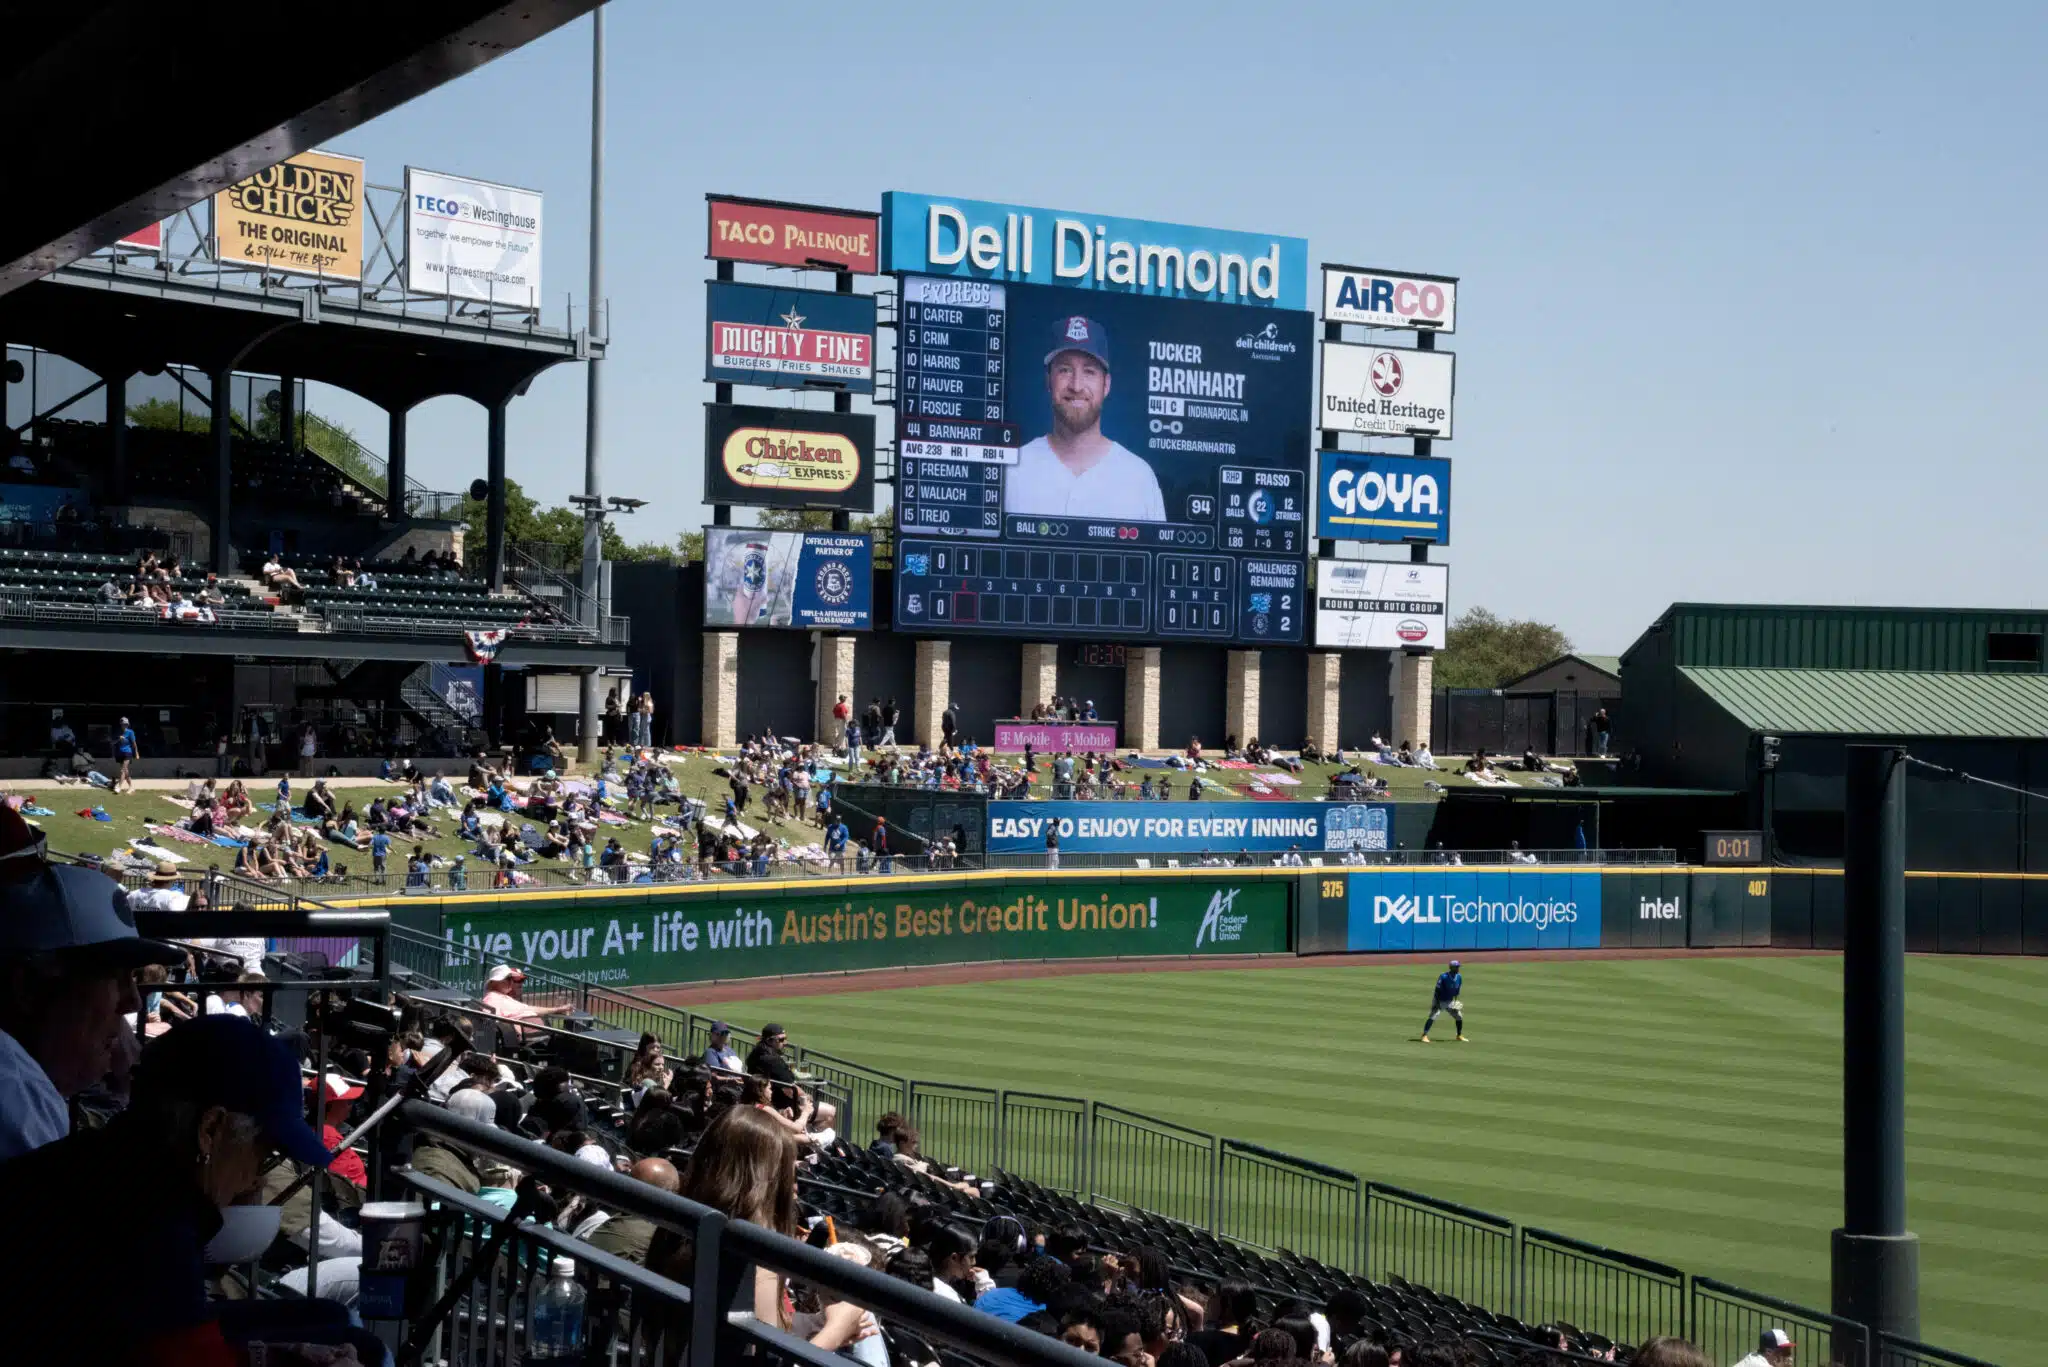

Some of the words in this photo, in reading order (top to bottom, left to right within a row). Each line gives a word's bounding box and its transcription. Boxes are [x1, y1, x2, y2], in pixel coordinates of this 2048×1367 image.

[241, 185, 340, 225] CHICK
[415, 194, 459, 216] TECO
[473, 205, 536, 229] Westinghouse
[238, 220, 267, 240] THE
[271, 226, 348, 253] ORIGINAL
[417, 228, 448, 239] together,
[461, 236, 493, 248] empower
[495, 241, 506, 249] the
[717, 220, 775, 245] TACO
[244, 243, 254, 258] &
[256, 245, 286, 259] STILL
[290, 251, 308, 263] THE
[312, 253, 338, 266] BEST
[928, 204, 1033, 274] Dell
[1054, 218, 1281, 300] Diamond
[425, 262, 526, 285] www.tecowestinghouse.com
[920, 281, 990, 304] EXPRESS
[924, 308, 963, 324] CARTER
[988, 314, 1002, 327] CF
[721, 326, 805, 357] MIGHTY
[815, 334, 864, 363] FINE
[909, 330, 916, 343] 5
[923, 331, 949, 345] CRIM
[990, 337, 1000, 350] 1B
[1236, 338, 1253, 349] dell
[1254, 340, 1296, 353] children's
[1148, 341, 1202, 364] TUCKER
[723, 355, 772, 368] BURGERS
[782, 360, 812, 372] FRIES
[820, 363, 861, 376] SHAKES
[907, 353, 917, 366] 10
[923, 355, 960, 370] HARRIS
[988, 360, 1000, 373] RF
[907, 376, 916, 389] 17
[923, 378, 963, 393] HAUVER
[988, 383, 999, 396] LF
[1148, 366, 1246, 399] BARNHART
[908, 400, 914, 412] 7
[922, 401, 961, 416] FOSCUE
[987, 406, 1000, 419] 2B
[1150, 399, 1161, 412] 44
[1170, 401, 1177, 413] C
[1188, 405, 1239, 422] INDIANAPOLIS,
[1240, 409, 1249, 421] IN
[1326, 395, 1376, 414] United
[1380, 400, 1445, 424] Heritage
[907, 422, 920, 436] 44
[929, 424, 982, 440] BARNHART
[1003, 430, 1011, 442] C
[1354, 417, 1386, 431] Credit
[745, 436, 843, 464] Chicken
[906, 443, 923, 454] AVG
[951, 446, 963, 457] HR
[983, 448, 996, 459] RBI
[998, 449, 1005, 459] 4
[1148, 437, 1236, 454] @TUCKERBARNHART16
[794, 467, 845, 481] EXPRESS
[906, 462, 913, 475] 6
[921, 462, 969, 479] FREEMAN
[985, 467, 999, 480] 3B
[1226, 472, 1240, 481] RHP
[1255, 472, 1290, 487] FRASSO
[905, 485, 914, 498] 12
[920, 486, 967, 501] WALLACH
[985, 490, 998, 503] DH
[1329, 469, 1438, 515] GOYA
[1192, 500, 1211, 515] 94
[1230, 494, 1240, 507] 10
[1256, 501, 1267, 512] 22
[1284, 498, 1293, 510] 12
[904, 508, 914, 521] 15
[920, 508, 950, 523] TREJO
[984, 512, 997, 526] SS
[1225, 508, 1245, 518] BALLS
[1275, 511, 1301, 521] STRIKES
[1016, 521, 1036, 534] BALL
[1088, 525, 1116, 538] STRIKE
[1159, 529, 1174, 541] OUT
[1229, 527, 1243, 535] ERA
[805, 537, 834, 546] OFFICIAL
[1228, 537, 1243, 548] 1.80
[1286, 539, 1292, 550] 3
[815, 547, 843, 556] PARTNER
[845, 548, 855, 556] OF
[938, 553, 945, 569] 0
[964, 554, 969, 570] 1
[1247, 562, 1297, 575] CHALLENGES
[1171, 564, 1175, 580] 1
[1192, 565, 1199, 581] 2
[1214, 567, 1221, 582] 0
[987, 581, 992, 591] 3
[1011, 582, 1017, 592] 4
[1036, 583, 1042, 593] 5
[1060, 584, 1065, 594] 6
[1083, 585, 1089, 595] 7
[1107, 586, 1112, 596] 8
[1131, 587, 1137, 597] 9
[1250, 576, 1295, 589] REMAINING
[1170, 589, 1176, 599] R
[1192, 590, 1198, 599] H
[1214, 591, 1219, 600] E
[1281, 594, 1291, 610] 2
[937, 599, 944, 615] 0
[1325, 600, 1354, 610] ROUND
[1358, 601, 1380, 610] ROCK
[1384, 602, 1406, 611] AUTO
[1409, 603, 1438, 612] GROUP
[1169, 608, 1176, 624] 0
[1193, 609, 1197, 624] 1
[1213, 610, 1220, 625] 0
[1280, 617, 1291, 631] 2
[1013, 732, 1050, 746] Mobile
[1074, 732, 1111, 746] Mobile
[992, 818, 1043, 838] EASY
[1078, 818, 1140, 838] ENJOY
[1144, 818, 1183, 838] FOR
[1188, 818, 1248, 837] EVERY
[1252, 818, 1318, 837] INNING
[1327, 831, 1345, 839] BUD
[1347, 828, 1365, 837] BUD
[1367, 831, 1385, 839] BUD
[1717, 838, 1749, 858] 0:01
[1322, 881, 1344, 898] 375
[1748, 880, 1767, 896] 407
[1220, 914, 1248, 923] Federal
[1374, 894, 1441, 925] DELL
[1440, 895, 1577, 930] Technologies
[445, 922, 512, 966] Live
[521, 927, 594, 971] your
[601, 920, 644, 956] A+
[652, 910, 699, 953] life
[707, 907, 773, 949] with
[779, 906, 886, 945] Austin's
[895, 901, 953, 938] Best
[959, 895, 1048, 934] Credit
[1057, 896, 1158, 930] Union!
[1220, 932, 1240, 940] Union
[588, 970, 599, 982] by
[601, 968, 630, 981] NCUA.
